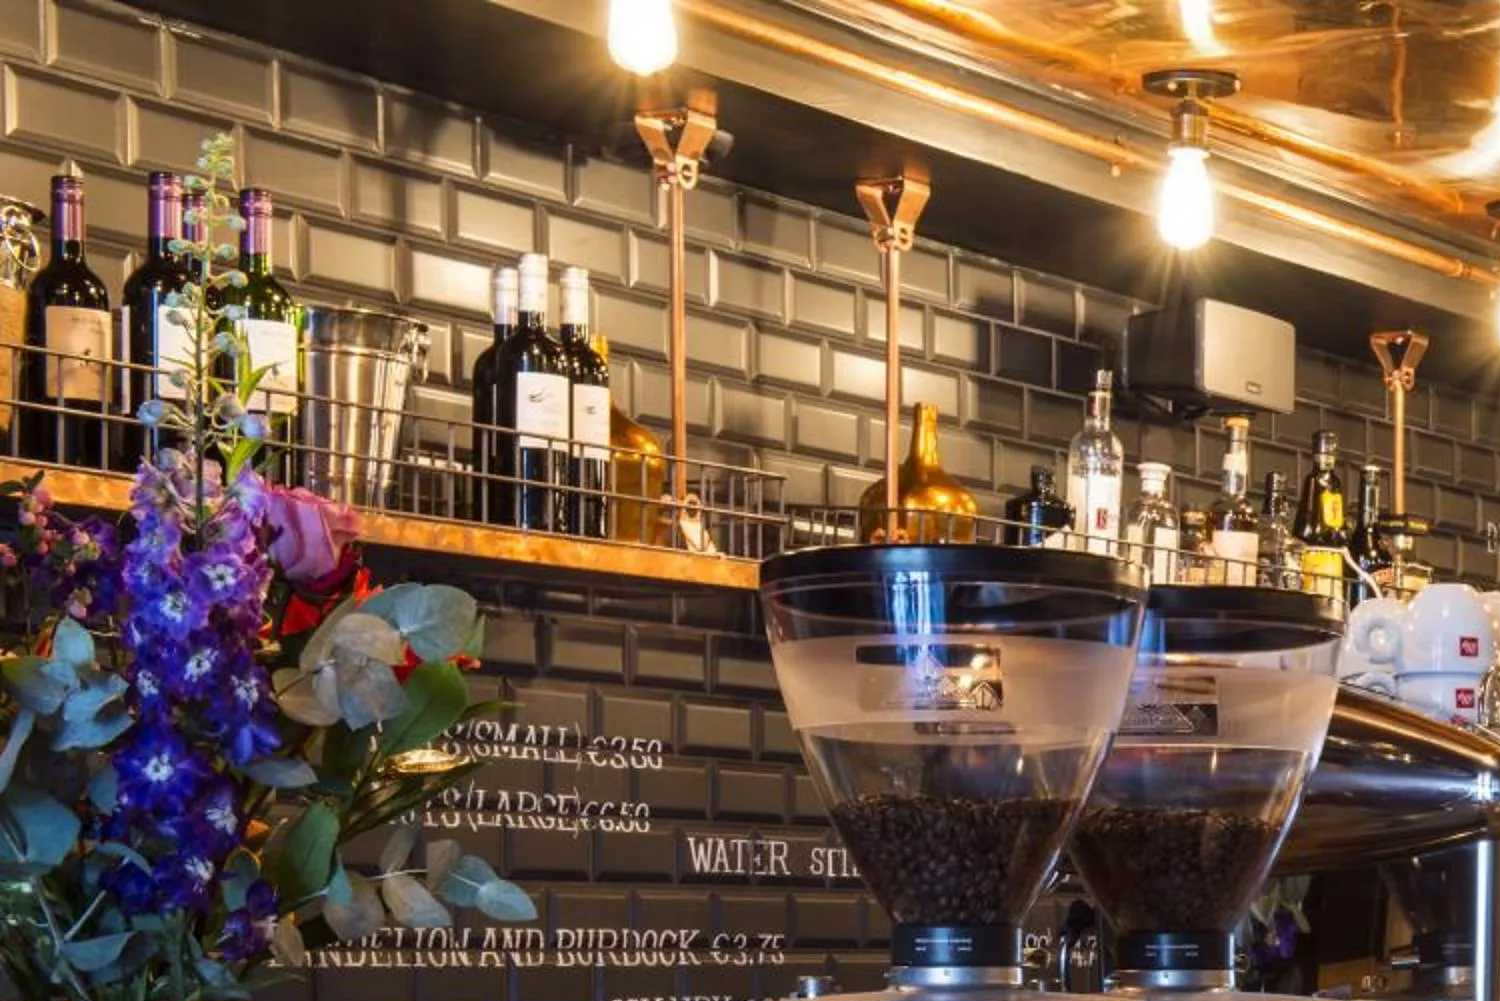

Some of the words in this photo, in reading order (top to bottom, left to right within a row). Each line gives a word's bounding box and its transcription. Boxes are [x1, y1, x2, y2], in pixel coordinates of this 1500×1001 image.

[687, 837, 791, 875] WATER
[480, 927, 544, 967] AND
[556, 928, 702, 967] BURDOCK
[711, 933, 785, 965] €3.75
